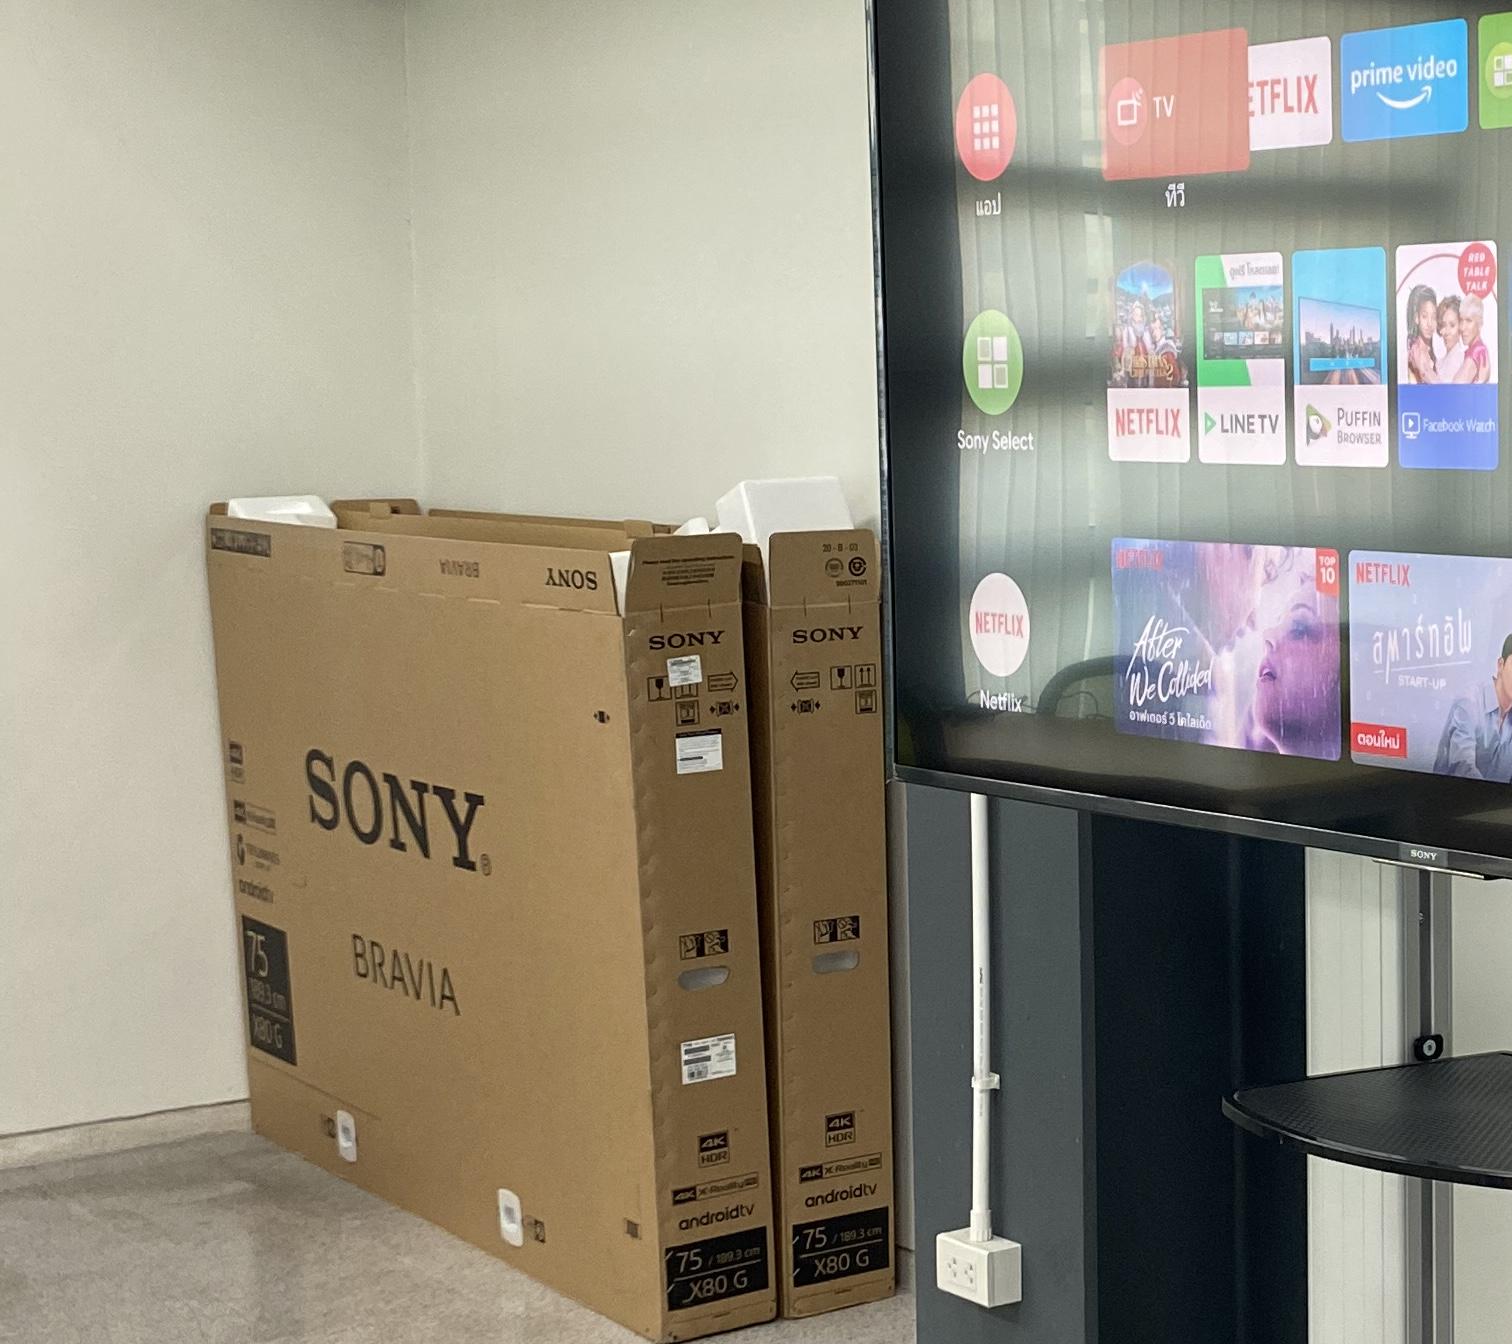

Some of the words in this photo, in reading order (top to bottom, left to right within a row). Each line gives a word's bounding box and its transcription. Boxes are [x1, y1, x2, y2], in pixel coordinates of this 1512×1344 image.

[1351, 62, 1403, 94] prime
[1407, 55, 1457, 81] video
[1248, 74, 1319, 116] ETFLIX
[1153, 95, 1175, 119] TV
[975, 192, 1002, 216] แอป
[1165, 183, 1185, 207] ทีวี
[1468, 252, 1486, 263] RED
[1463, 266, 1490, 277] TABLE
[1465, 280, 1488, 291] TALK
[1115, 408, 1181, 438] NETFLIX
[1337, 408, 1381, 427] PUFFIN
[1423, 418, 1464, 433] Facebook
[1466, 419, 1495, 433] Watch
[957, 429, 989, 454] Sony
[992, 431, 1034, 450] Select
[1337, 431, 1382, 445] BROWSER
[1319, 556, 1336, 566] TOP
[545, 567, 598, 590] SONY
[1320, 567, 1335, 584] 10
[1356, 562, 1410, 587] NETFLIX
[792, 626, 863, 644] SONY
[975, 611, 1024, 638] NETFLIX
[649, 630, 725, 650] SONY
[1126, 615, 1190, 680] After
[1129, 663, 1156, 706] We
[1158, 659, 1213, 703] Collided
[1398, 675, 1447, 691] START-UP
[980, 689, 1022, 713] Netflix
[1357, 729, 1400, 750] ตอนใหม่
[1410, 849, 1437, 861] SONY
[352, 933, 461, 1017] BRAVIA
[828, 1117, 851, 1128] 4K
[701, 1136, 727, 1148] 4K
[828, 1131, 853, 1144] HDR
[701, 1151, 728, 1164] HDR
[802, 1226, 827, 1250] 75
[840, 1228, 865, 1243] 189.3
[866, 1226, 882, 1237] cm
[676, 1248, 702, 1273] 75
[814, 1252, 850, 1278] X80
[856, 1248, 870, 1267] G
[682, 1275, 728, 1304] X80
[733, 1269, 748, 1289] G
